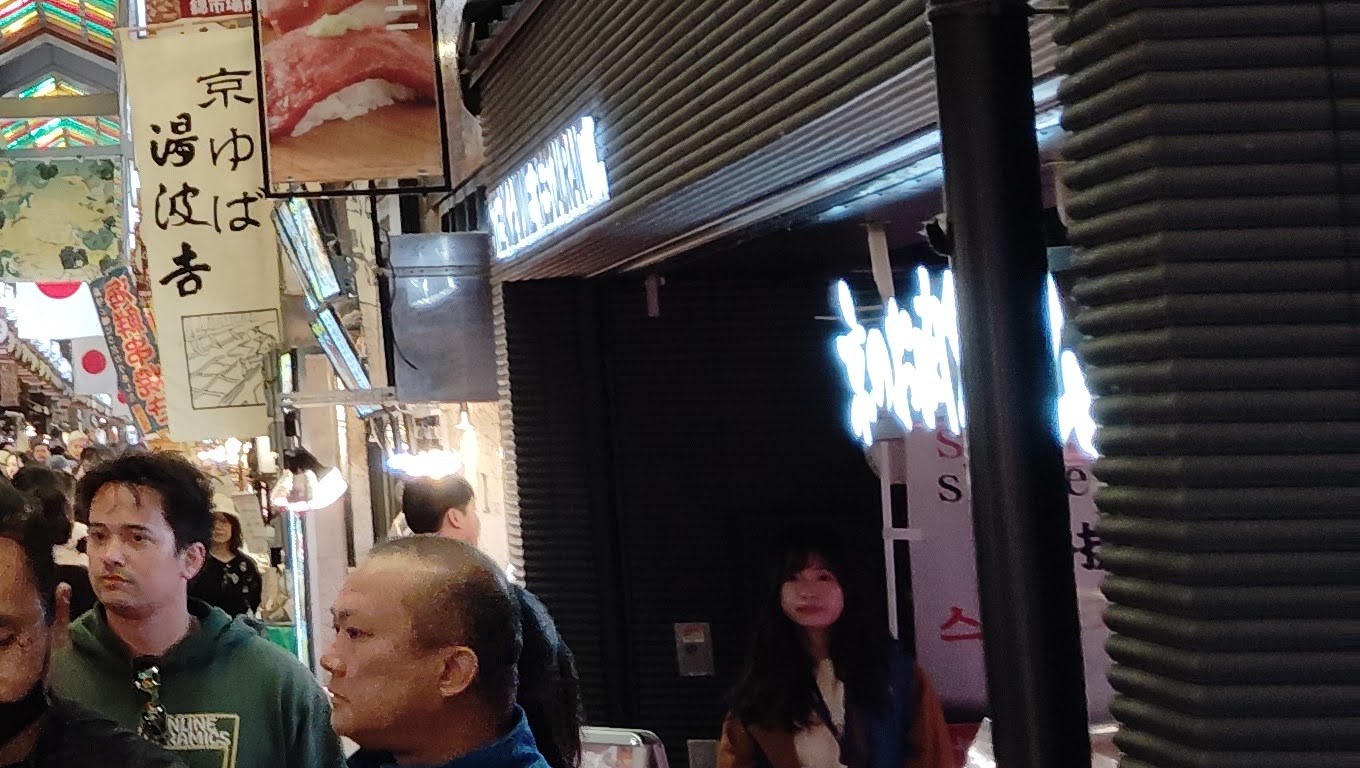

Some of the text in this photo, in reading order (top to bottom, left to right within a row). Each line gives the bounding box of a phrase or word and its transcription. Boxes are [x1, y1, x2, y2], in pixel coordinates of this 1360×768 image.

[197, 67, 265, 234] 京ゆば
[166, 715, 218, 734] NLINE
